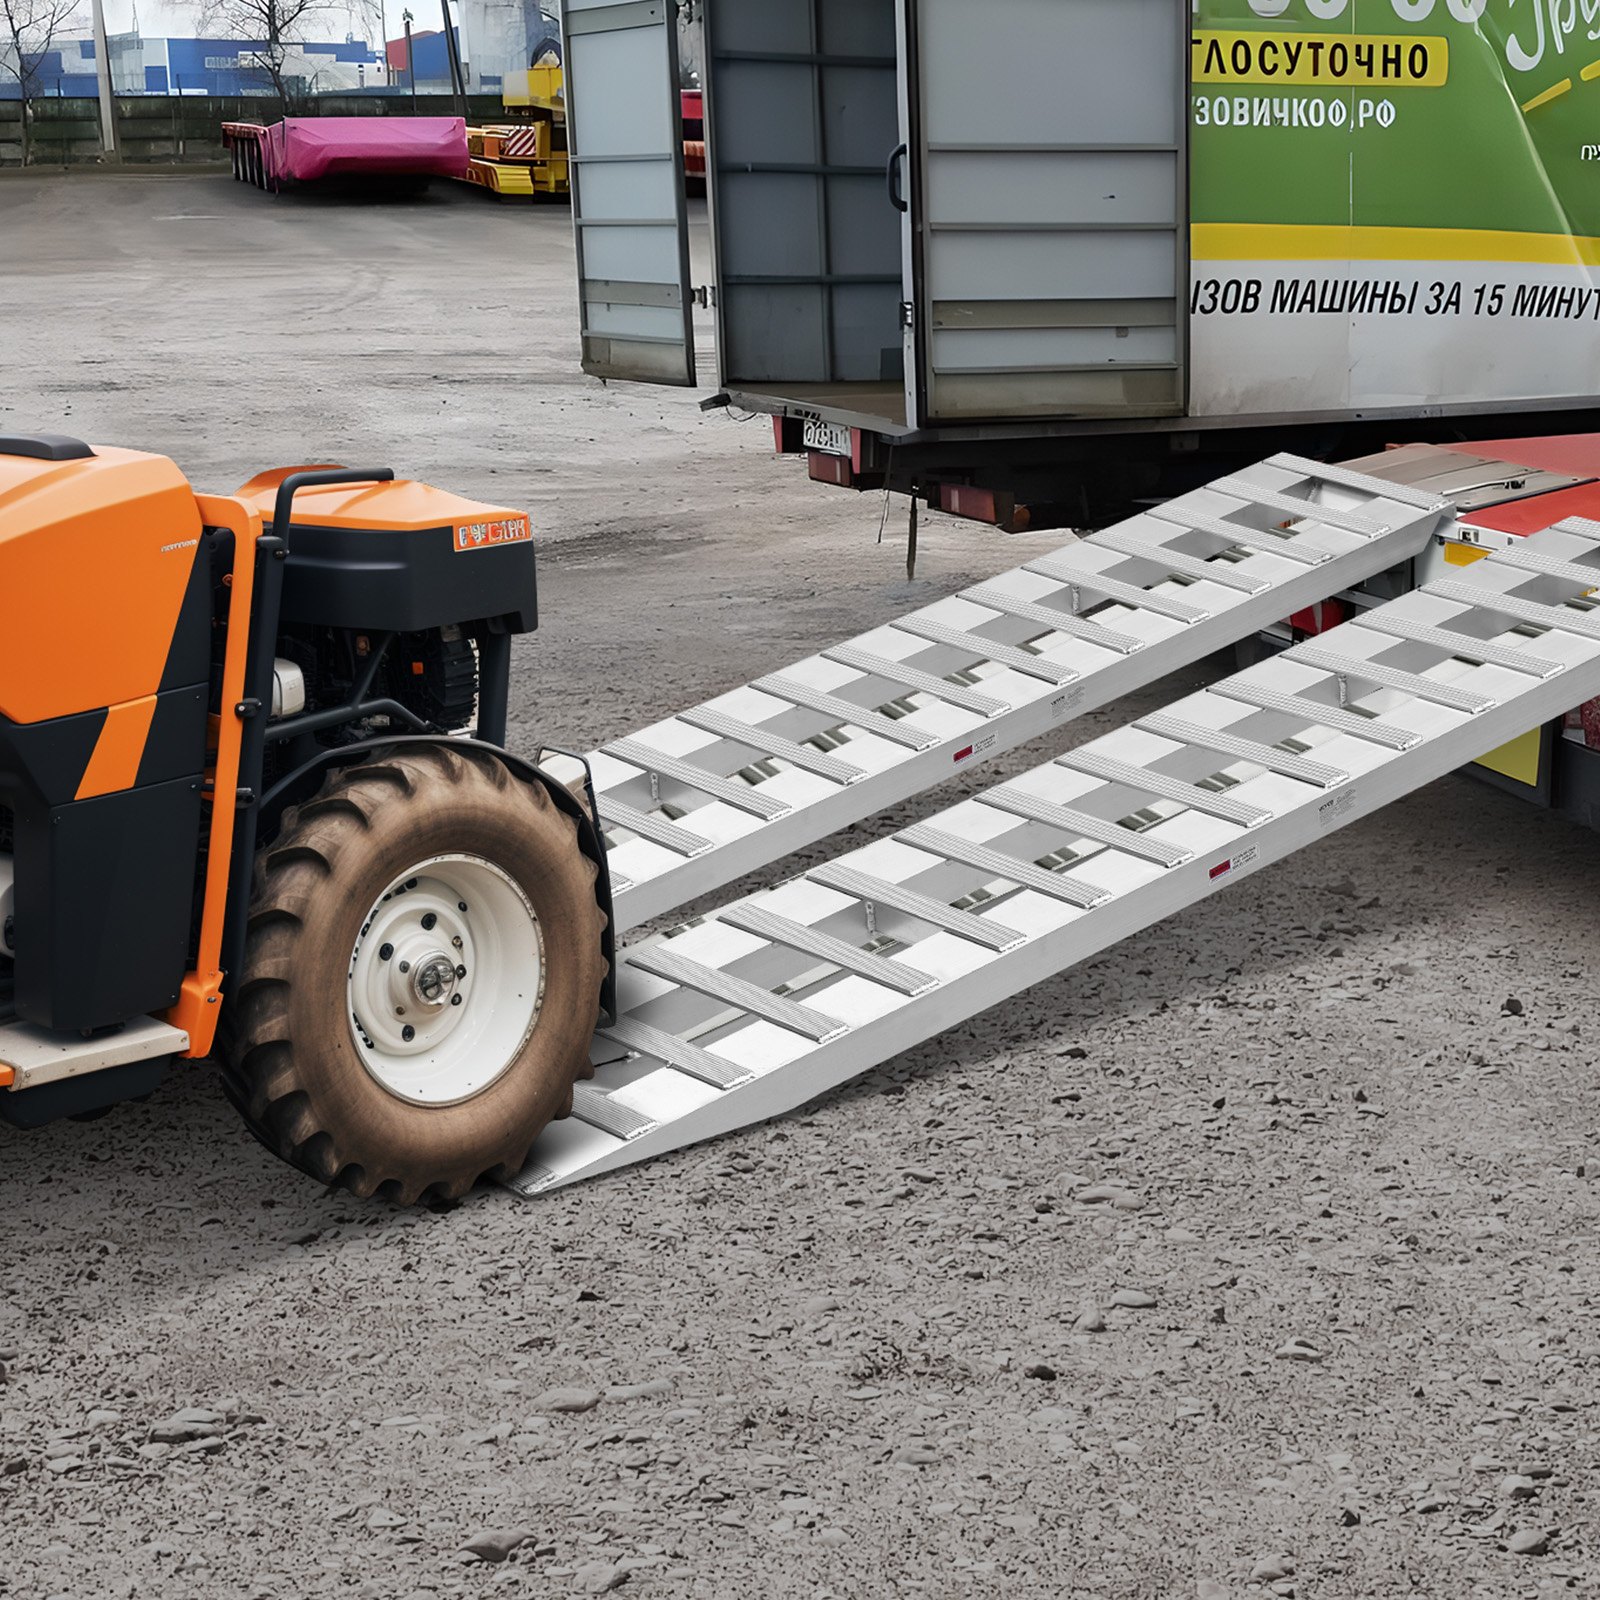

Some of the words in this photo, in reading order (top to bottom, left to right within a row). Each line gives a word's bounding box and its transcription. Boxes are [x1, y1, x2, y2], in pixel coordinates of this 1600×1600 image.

[1269, 279, 1419, 315] МАШИНЫ
[1424, 281, 1462, 315] ЗА
[1473, 283, 1507, 316] 15
